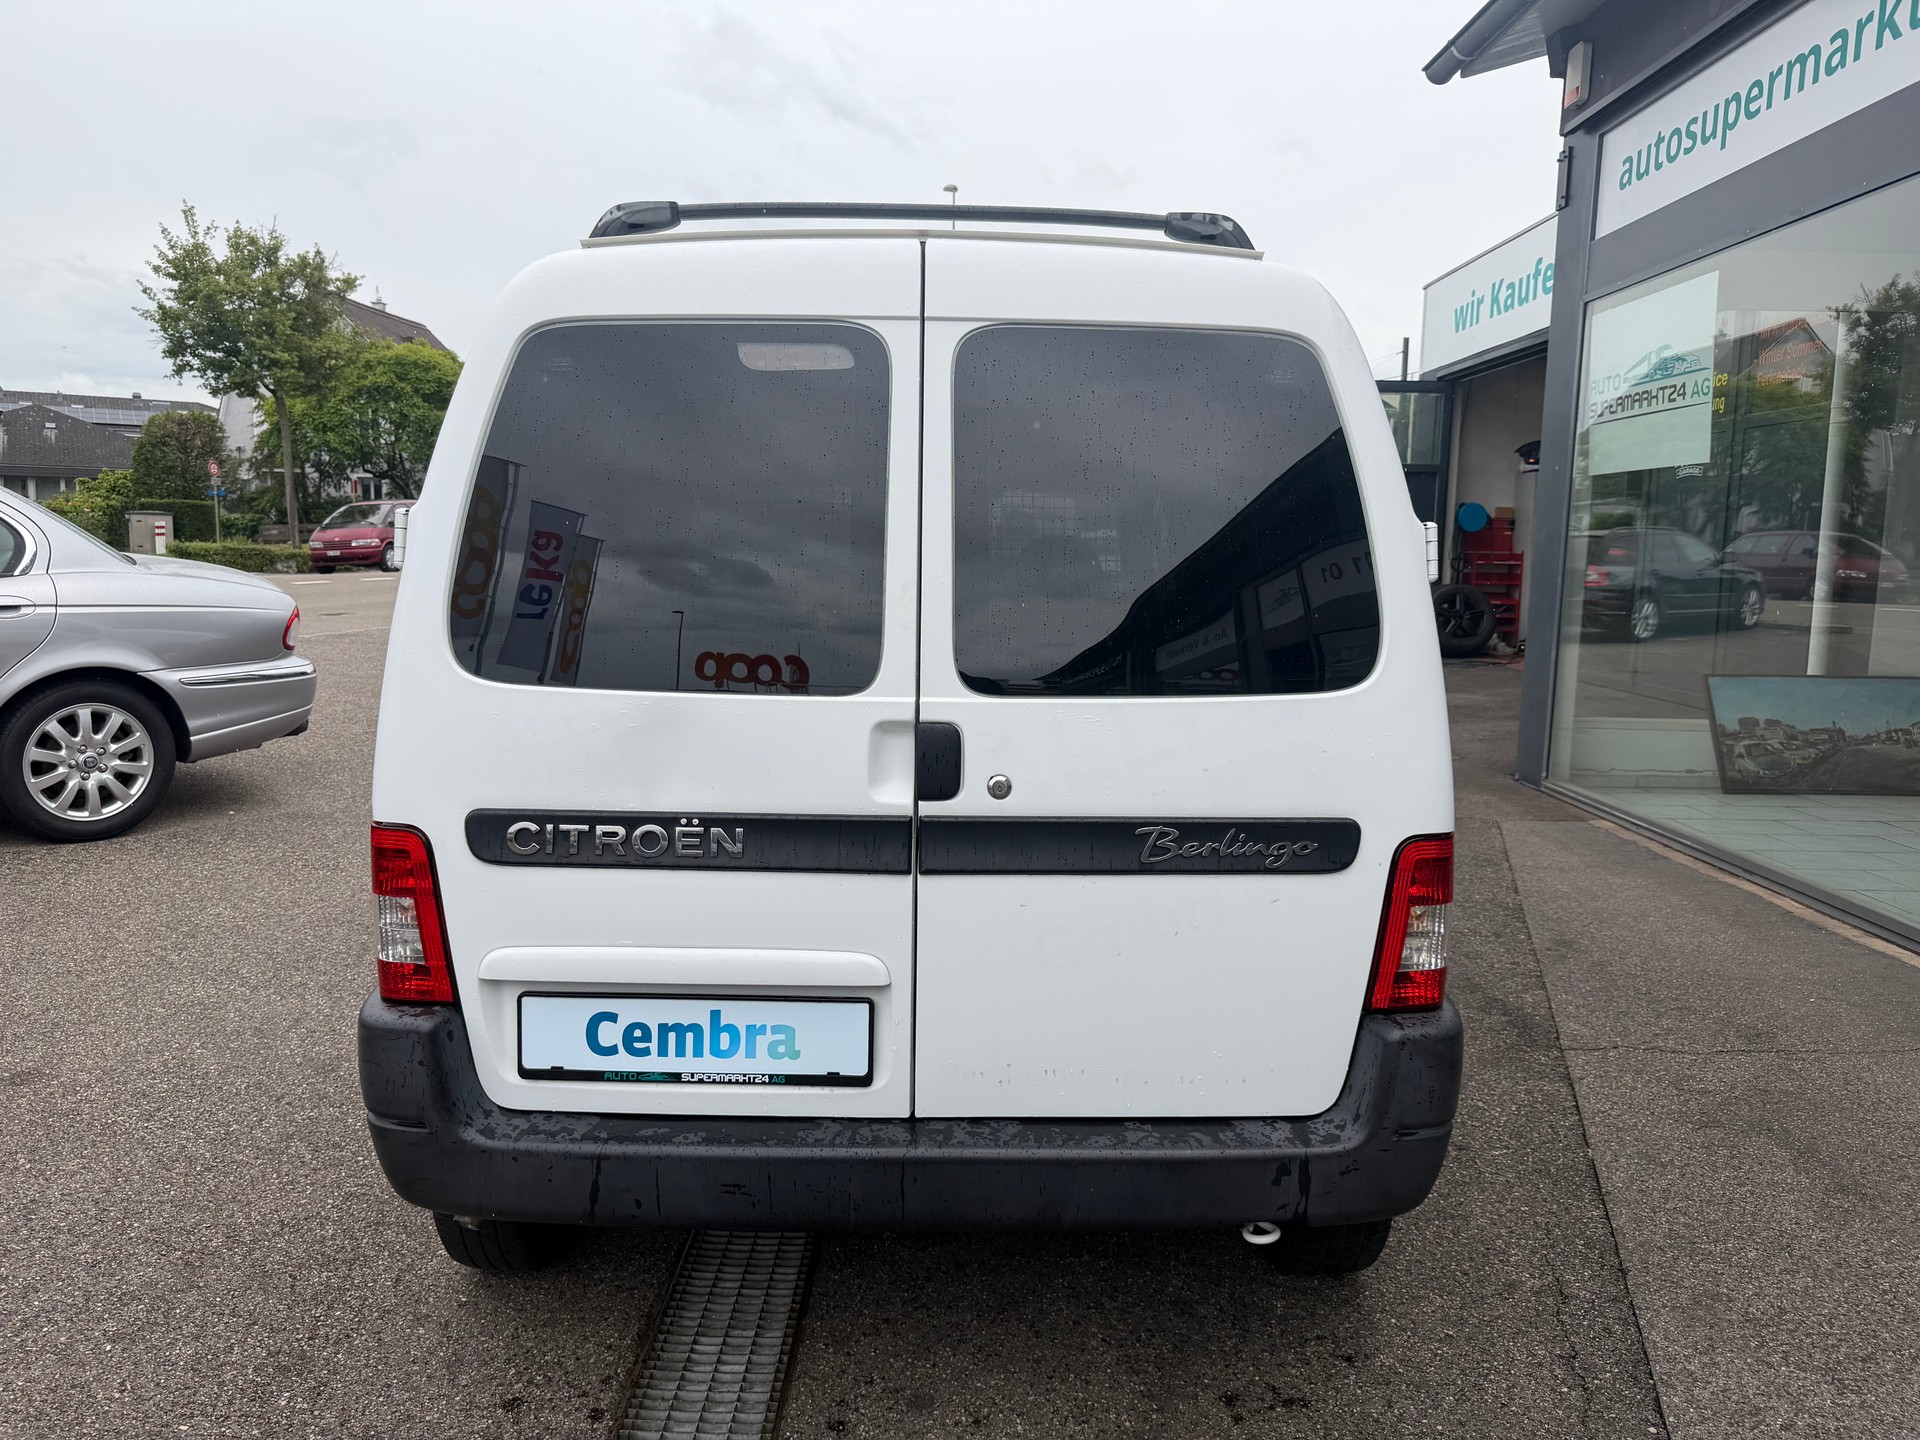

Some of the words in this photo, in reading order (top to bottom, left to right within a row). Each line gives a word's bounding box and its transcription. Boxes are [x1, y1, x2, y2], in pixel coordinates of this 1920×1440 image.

[1453, 289, 1484, 333] wir
[1588, 382, 1687, 420] SUPERMARKT24
[1690, 378, 1711, 399] AG
[1590, 373, 1621, 396] AUTO
[505, 817, 745, 859] CITROËN
[1134, 824, 1319, 869] Berlingo
[585, 1009, 801, 1061] Cembra
[604, 1071, 637, 1081] AUTO
[680, 1073, 770, 1083] SUPERMARKT24
[771, 1074, 786, 1084] AG
